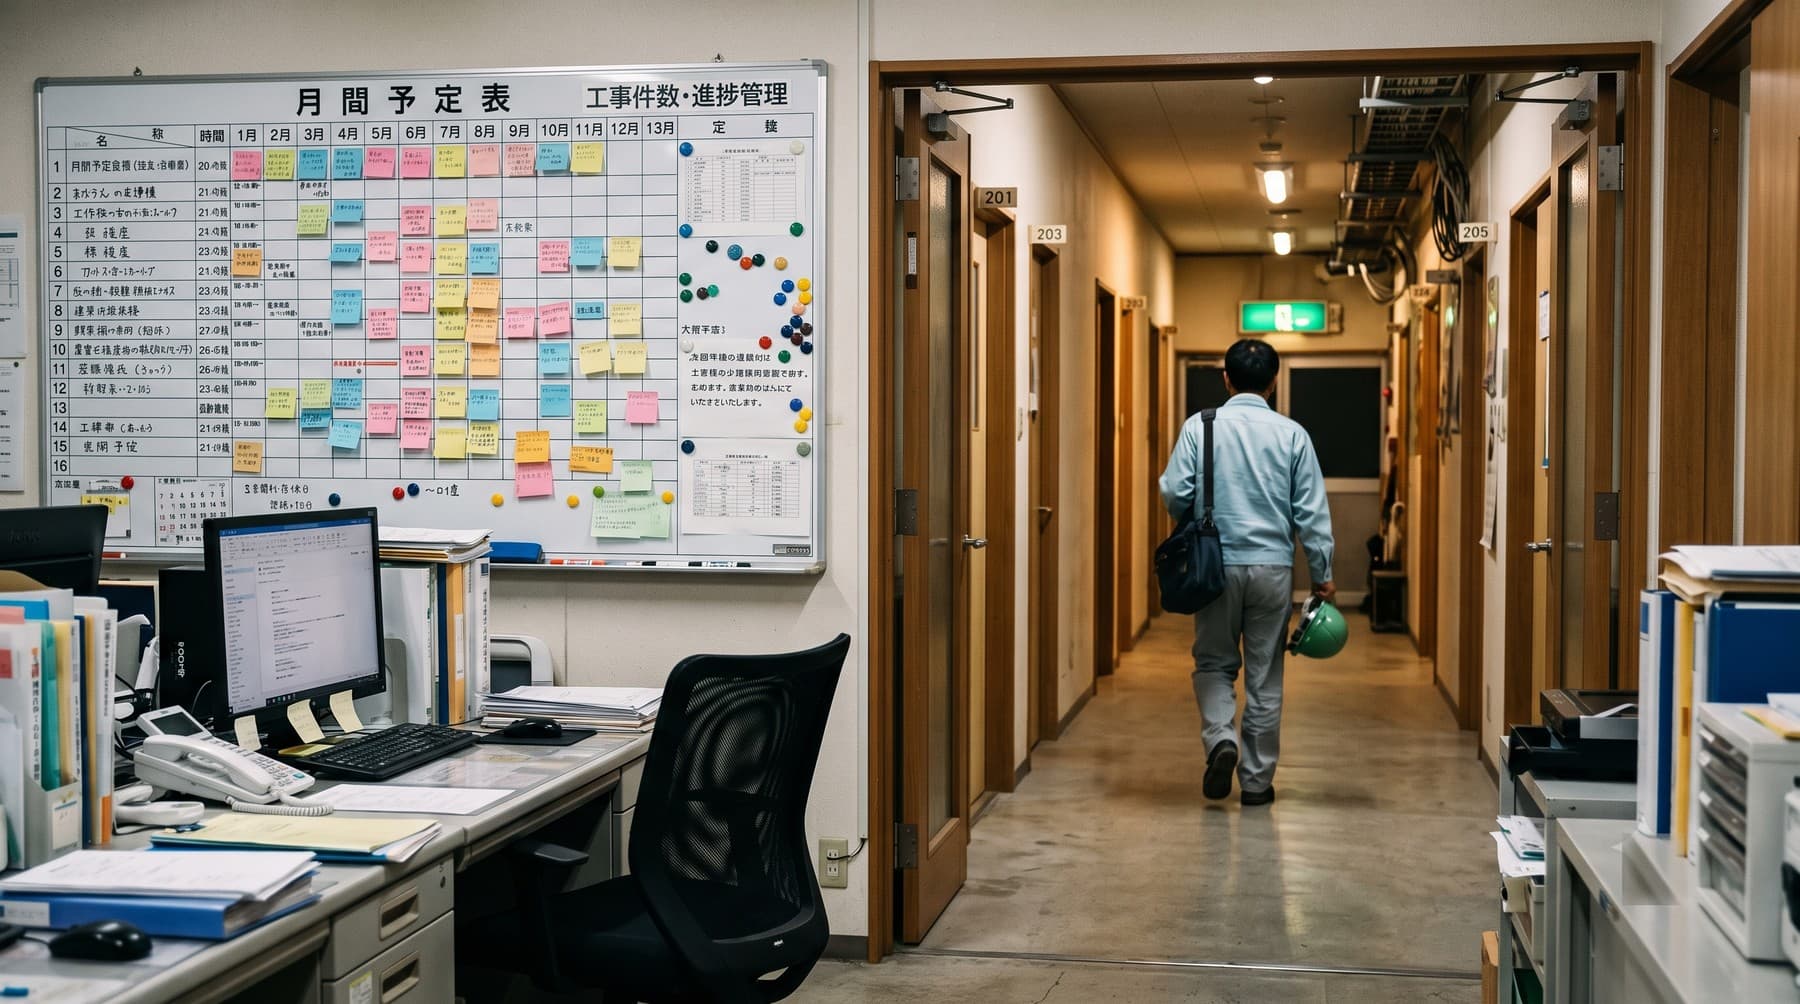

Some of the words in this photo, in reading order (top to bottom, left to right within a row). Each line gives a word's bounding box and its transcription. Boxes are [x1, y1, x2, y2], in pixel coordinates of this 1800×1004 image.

[296, 82, 510, 116] 月間予定表
[587, 82, 787, 109] 工事件数・進捗管理
[372, 127, 391, 139] 5月
[406, 127, 425, 139] 6月
[441, 126, 459, 138] 7月
[475, 125, 494, 138] 8月
[510, 125, 529, 137] 9月
[542, 124, 568, 136] 10月
[577, 123, 602, 136] 11月
[612, 123, 638, 135] 12月
[648, 122, 673, 134] 13月
[713, 121, 725, 133] 定
[200, 130, 224, 142] 時間
[238, 129, 256, 141] 1月
[271, 129, 289, 141] 2月
[305, 128, 323, 140] 3月
[338, 128, 357, 140] 4月
[97, 135, 107, 146] 名
[54, 161, 60, 172] 1
[53, 187, 61, 199] 2
[985, 191, 1010, 204] 201
[53, 207, 61, 218] 3
[54, 226, 62, 238] 4
[1038, 229, 1061, 240] 203
[1464, 226, 1488, 238] 205
[55, 246, 62, 257] 5
[55, 266, 62, 277] 6
[55, 285, 62, 296] 7
[55, 305, 62, 316] 8
[55, 324, 62, 336] 9
[53, 344, 65, 355] 10
[54, 363, 64, 374] 11
[54, 383, 66, 394] 12
[54, 402, 66, 413] 13
[53, 421, 67, 433] 14
[54, 440, 67, 452] 15
[54, 460, 67, 471] 16
